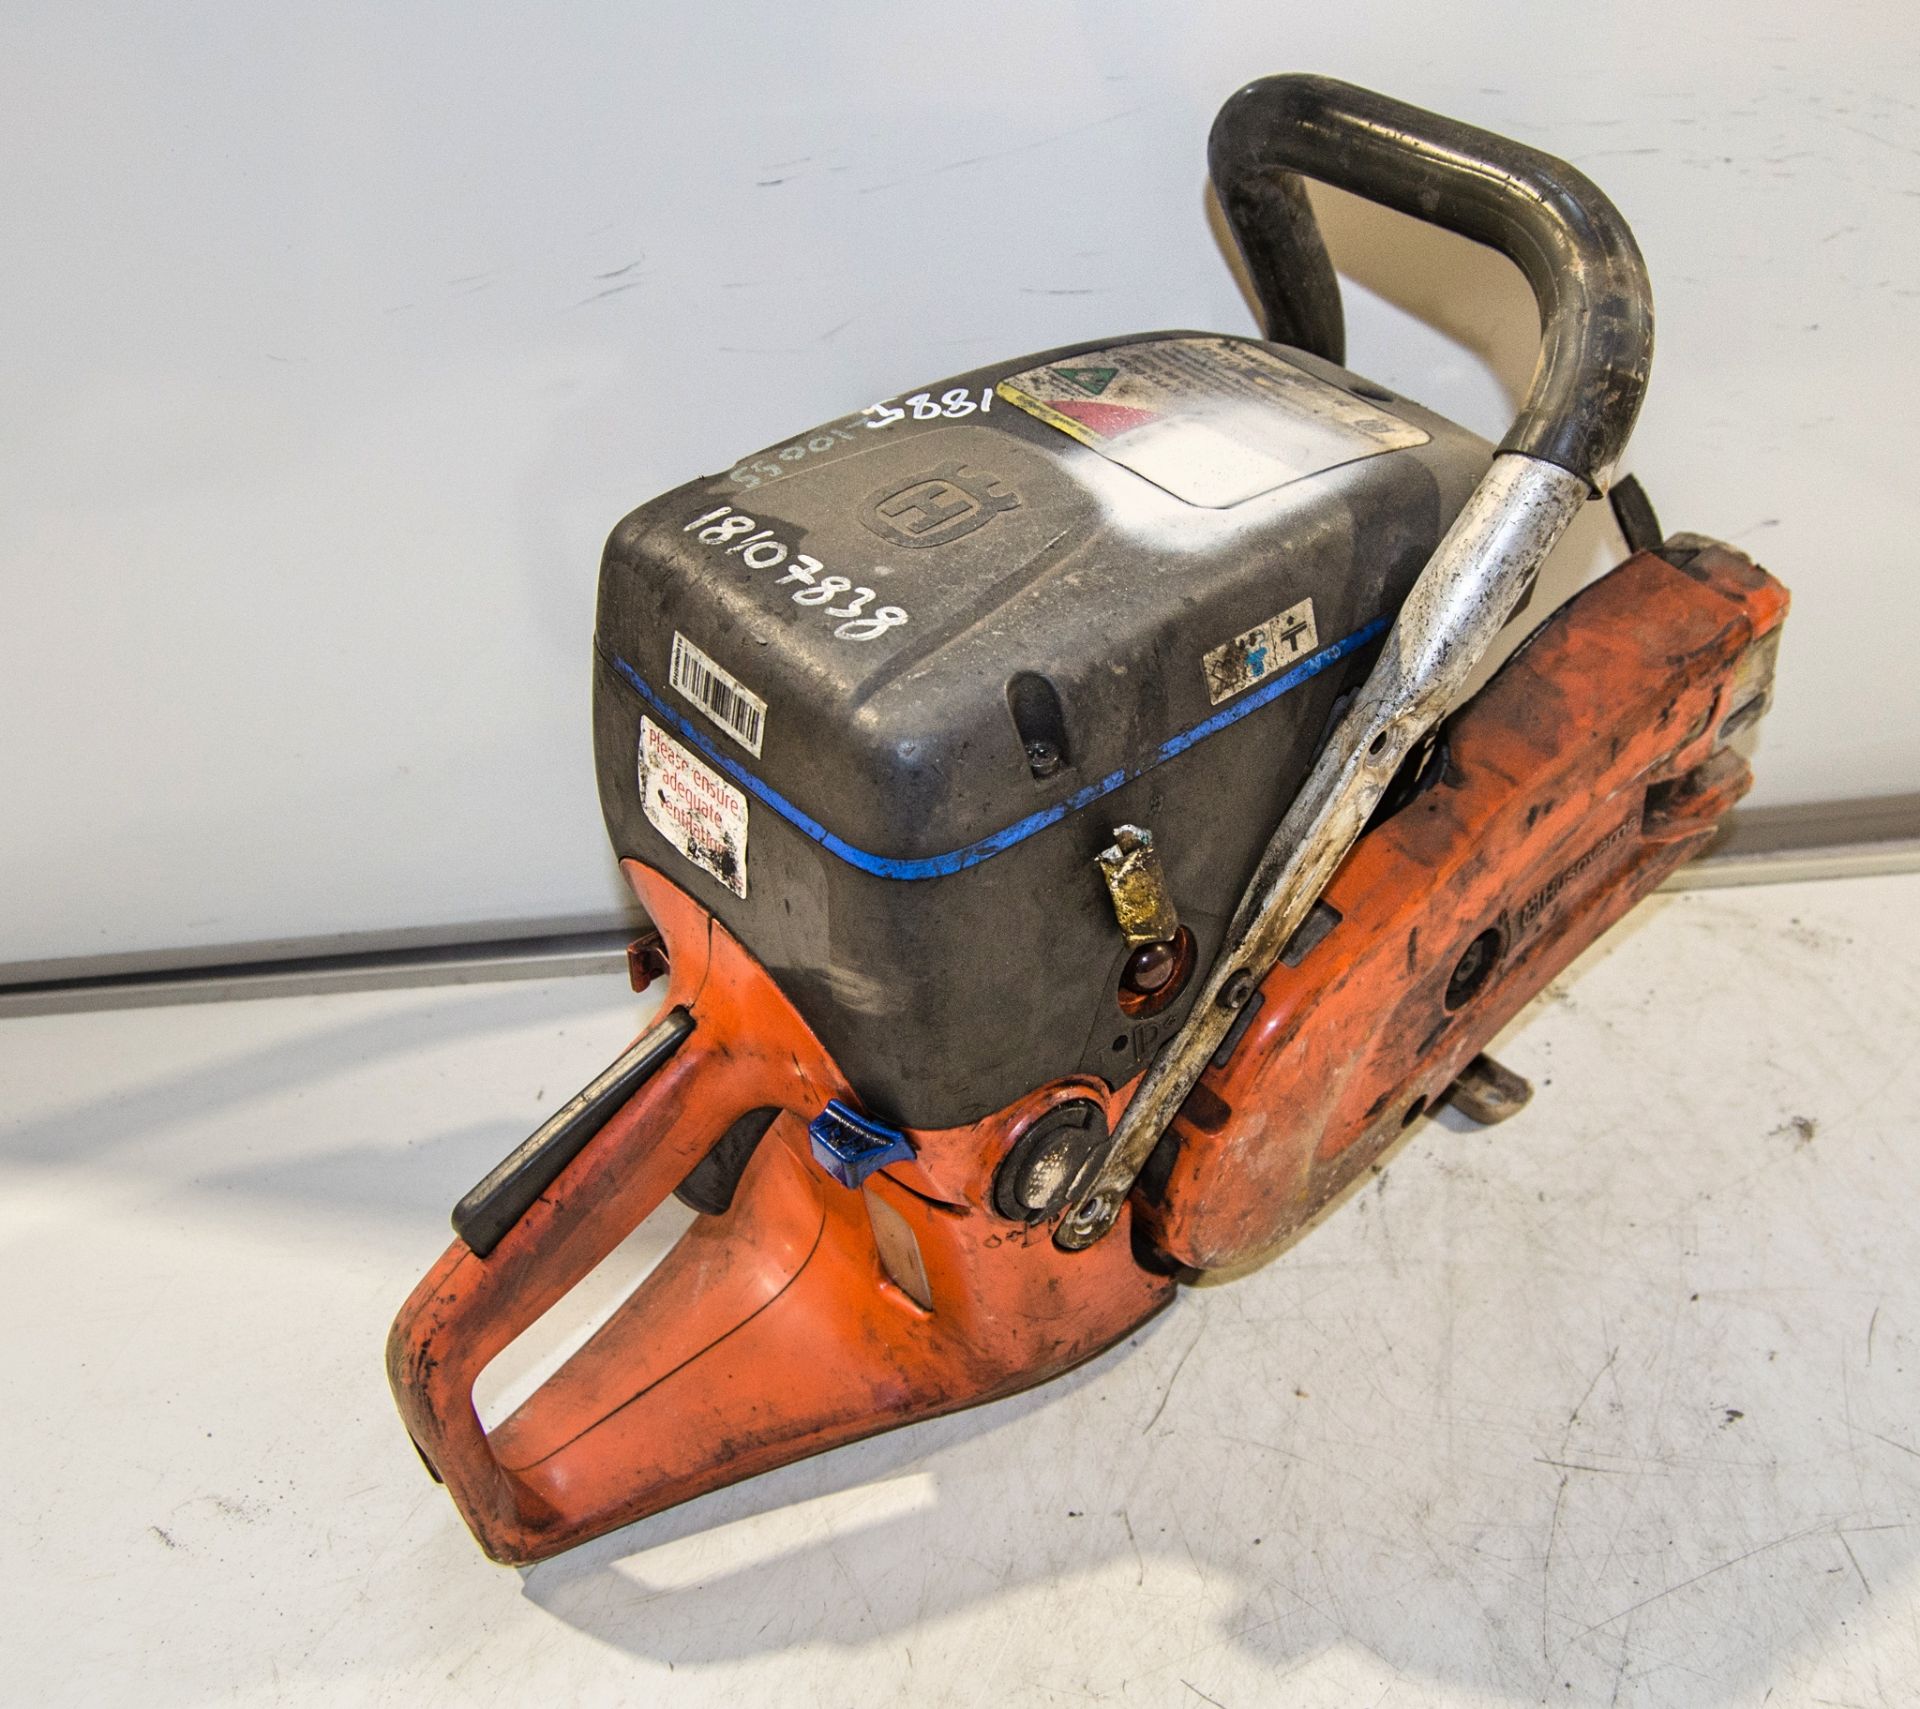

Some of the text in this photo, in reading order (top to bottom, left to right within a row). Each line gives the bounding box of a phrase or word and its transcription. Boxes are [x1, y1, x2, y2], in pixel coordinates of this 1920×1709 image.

[683, 506, 909, 642] 18107838
[649, 728, 738, 817] Please ensure
[662, 769, 723, 829] adequate
